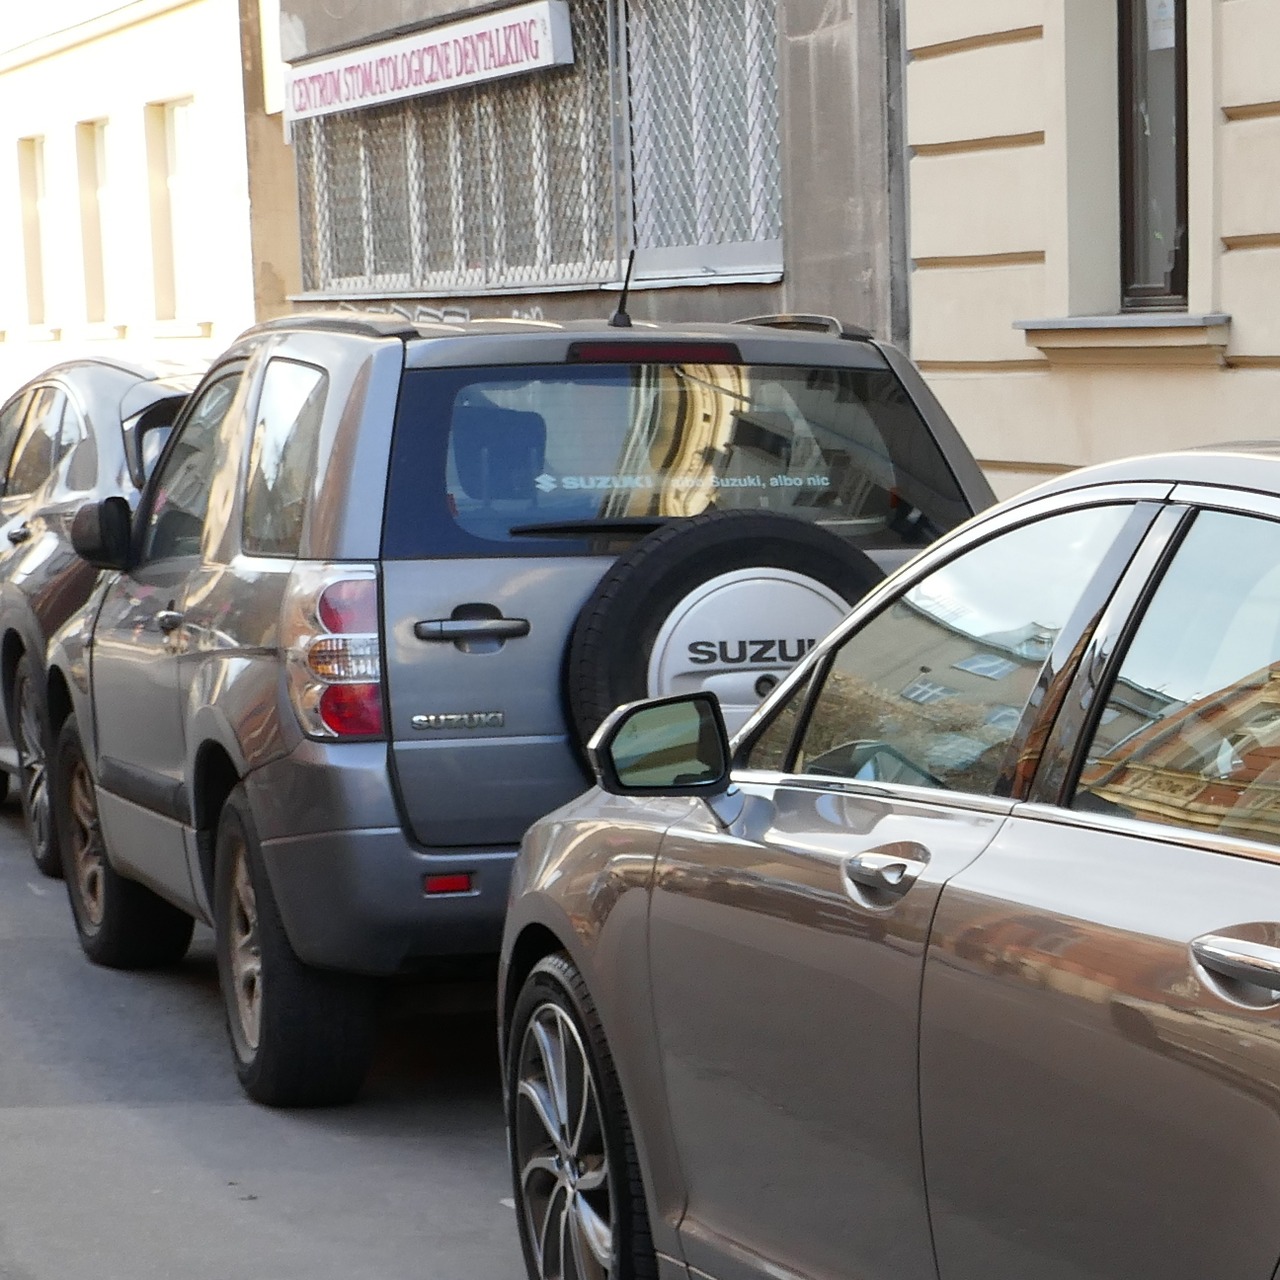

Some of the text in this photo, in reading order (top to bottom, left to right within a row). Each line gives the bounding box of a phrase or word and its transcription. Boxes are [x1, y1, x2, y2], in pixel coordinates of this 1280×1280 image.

[292, 19, 540, 112] CENTRUM STOMATOLOGICZNE DENTALKING
[562, 474, 653, 490] SUZUKI
[711, 474, 767, 490] Suzuki,
[769, 474, 803, 488] albo
[806, 474, 831, 488] nic
[687, 638, 817, 665] SUZU
[411, 710, 505, 731] SUZUKI
